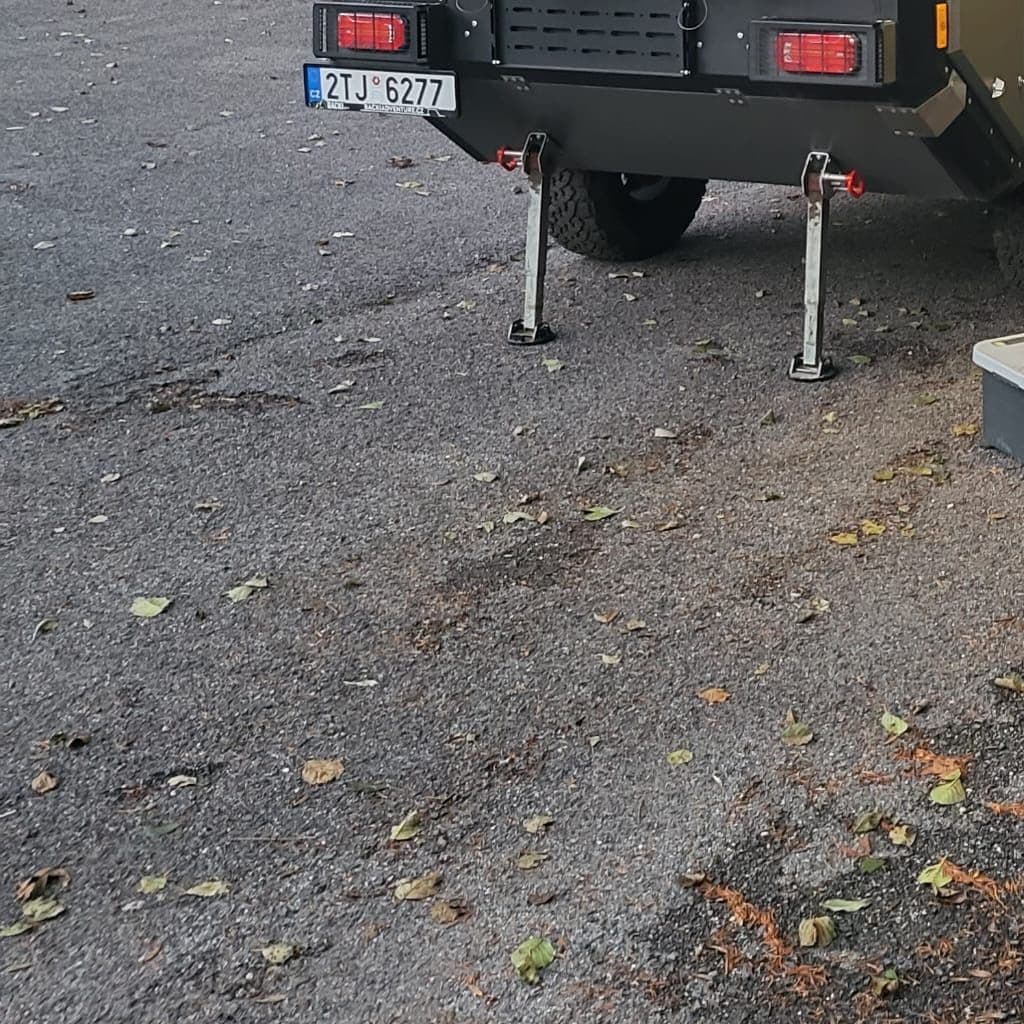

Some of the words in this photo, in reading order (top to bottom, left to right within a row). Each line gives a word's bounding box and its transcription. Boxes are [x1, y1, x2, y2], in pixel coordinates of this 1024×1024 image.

[309, 89, 321, 98] CZ
[325, 72, 368, 101] 2TJ
[386, 76, 443, 106] 6277
